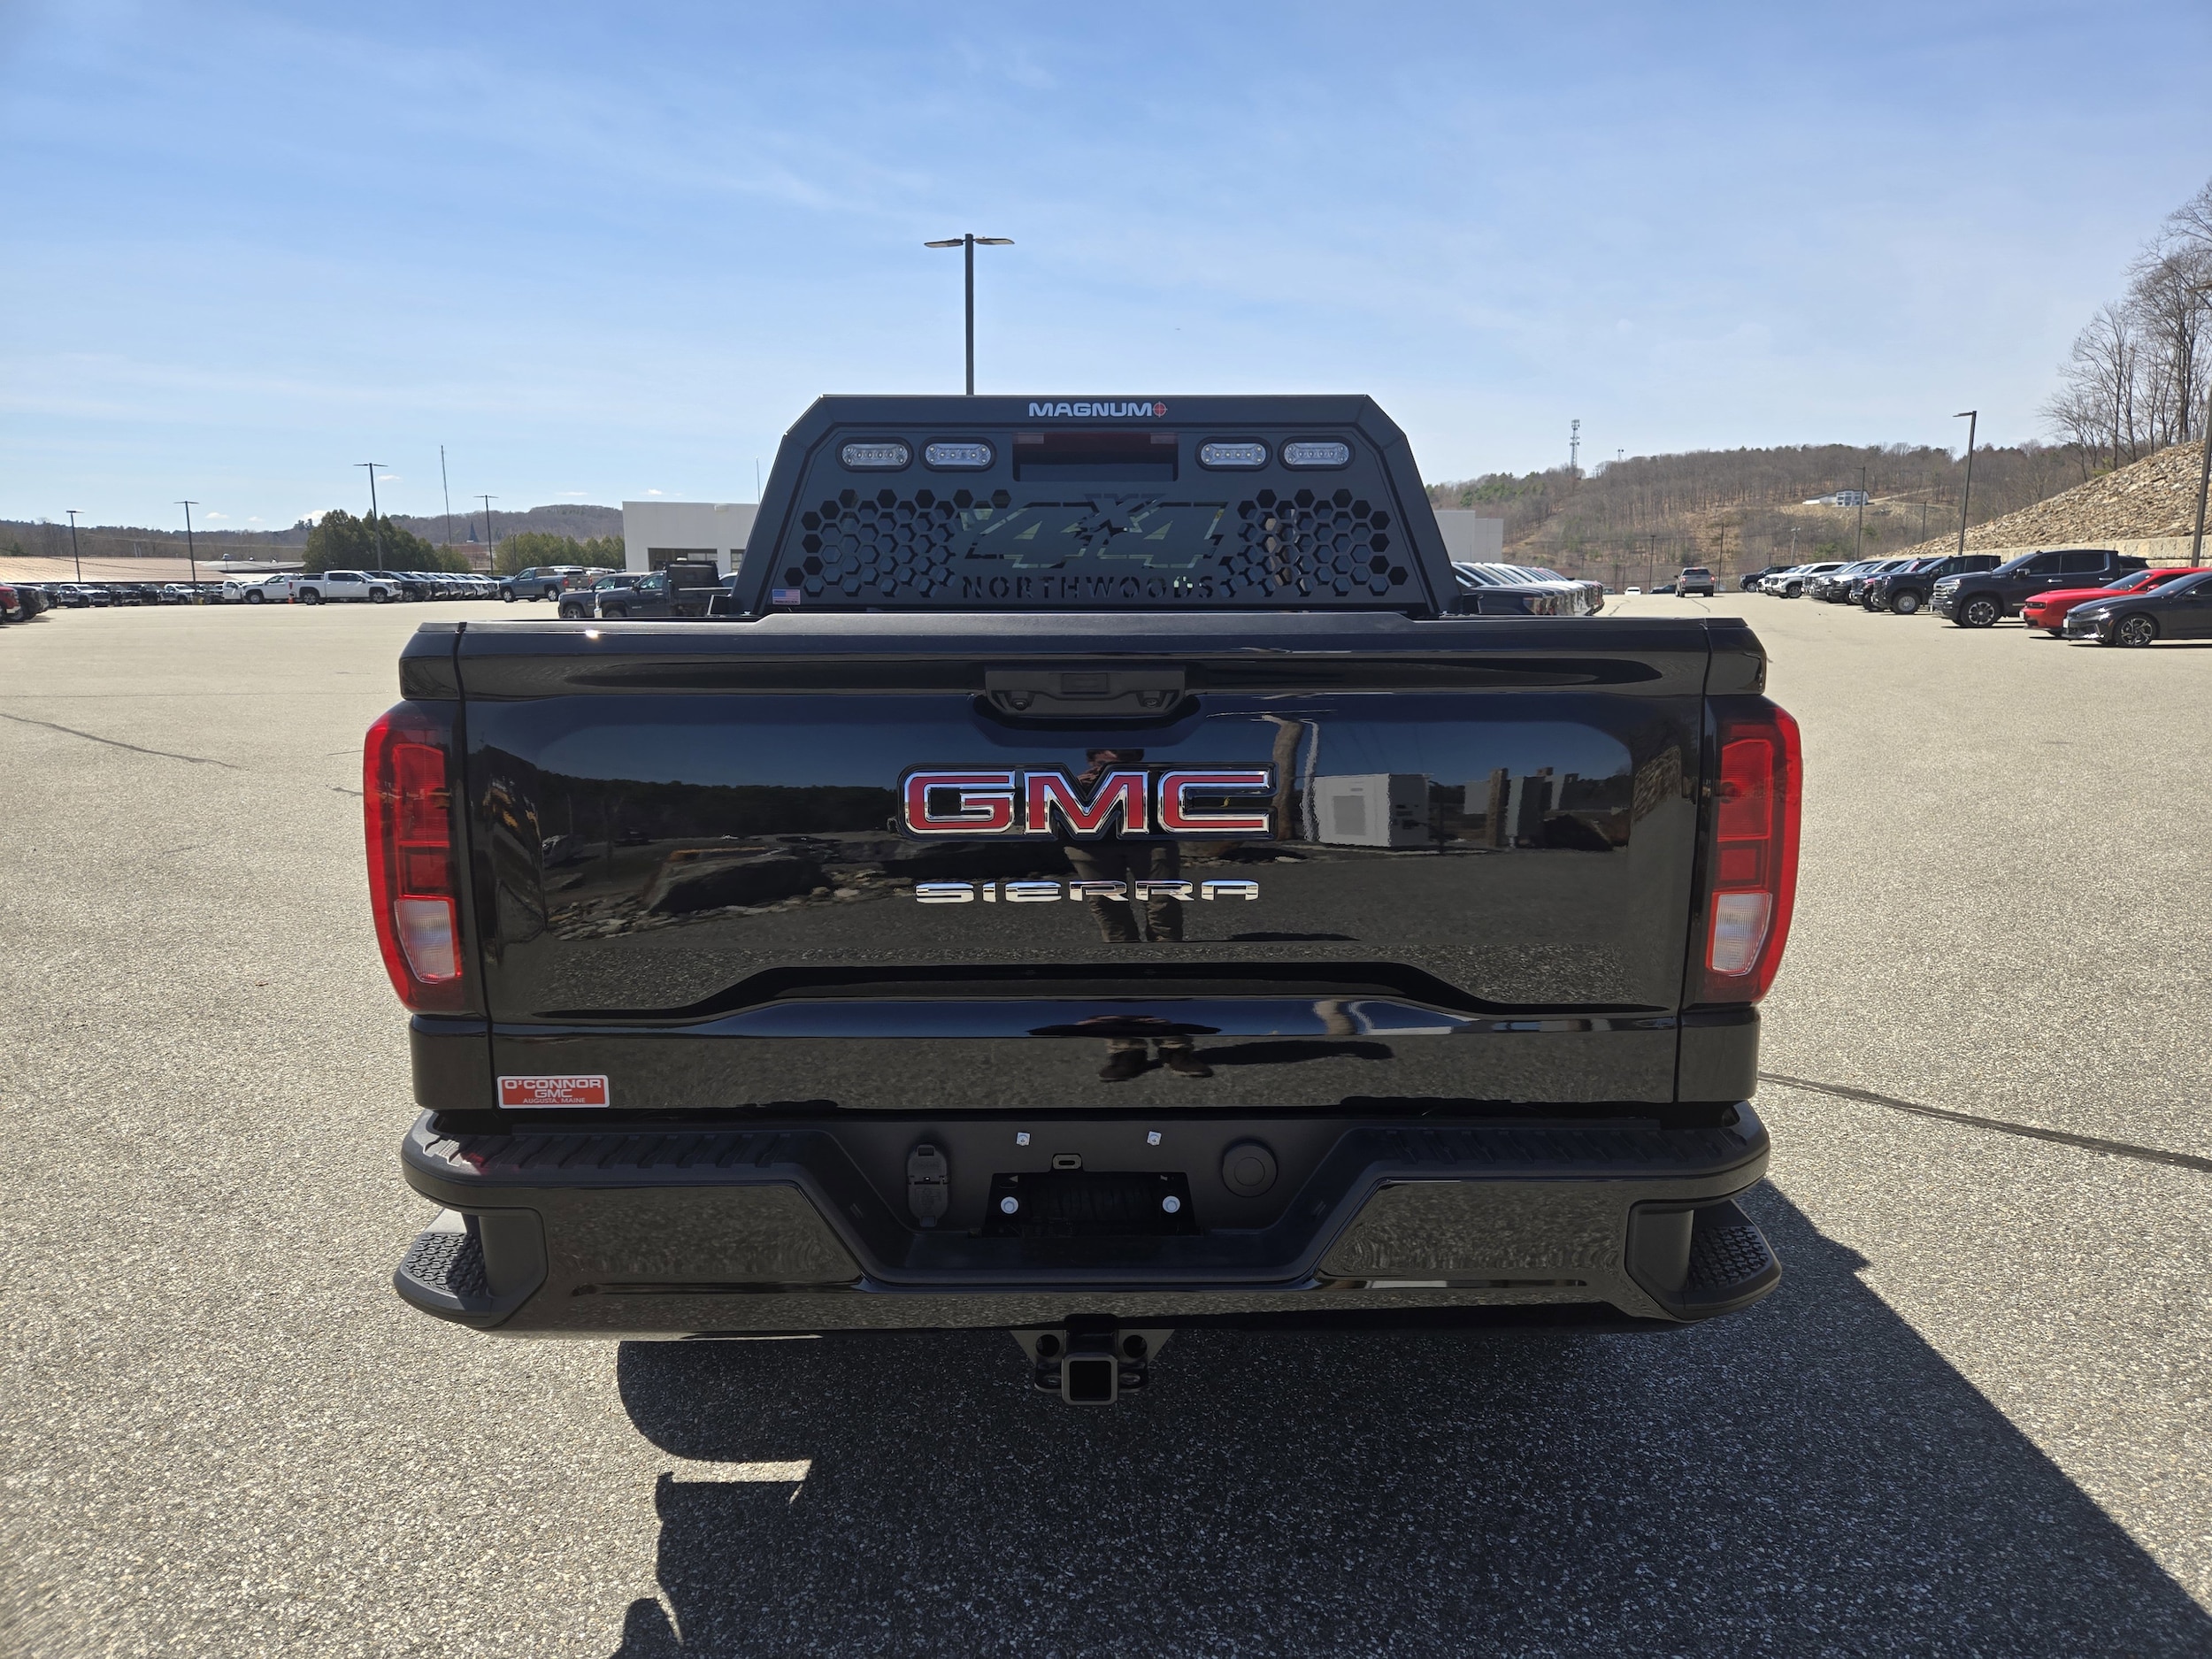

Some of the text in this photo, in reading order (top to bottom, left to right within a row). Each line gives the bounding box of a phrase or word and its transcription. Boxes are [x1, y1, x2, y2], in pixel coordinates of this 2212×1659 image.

[1028, 402, 1153, 417] MAGNUM
[962, 575, 1214, 600] NORTHWOODS
[902, 770, 1271, 834] GMC
[914, 879, 1260, 904] SIERRA
[504, 1079, 602, 1089] O'CONNOR
[534, 1089, 572, 1098] GMC
